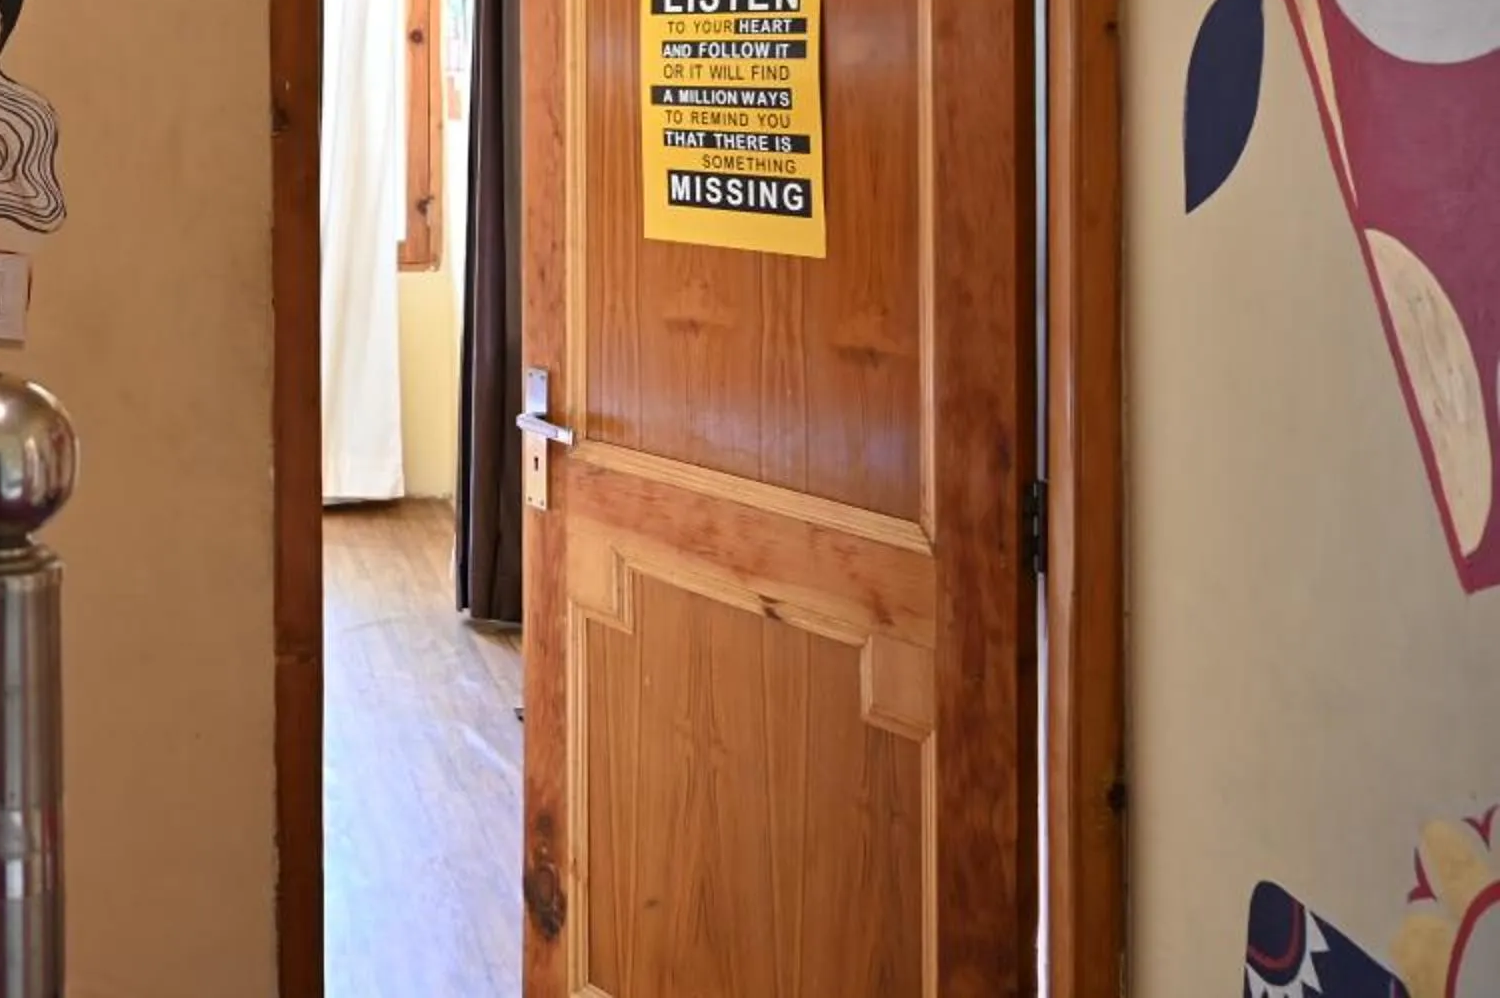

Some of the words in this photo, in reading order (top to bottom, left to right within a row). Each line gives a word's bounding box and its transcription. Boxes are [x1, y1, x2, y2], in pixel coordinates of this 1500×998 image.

[667, 20, 685, 35] TO
[693, 20, 733, 34] YOUR
[739, 19, 793, 33] HEART
[663, 44, 692, 58] AND
[699, 42, 770, 58] FOLLOW
[775, 43, 790, 57] IT
[663, 64, 685, 79] OR
[689, 65, 703, 79] IT
[709, 65, 745, 80] WILL
[751, 65, 790, 81] FIND
[663, 89, 673, 103] A
[679, 89, 738, 105] MILLION
[741, 91, 790, 107] WAYS
[665, 110, 683, 124] TO
[691, 111, 749, 127] REMIND
[757, 113, 791, 129] YOU
[665, 131, 708, 146] THAT
[713, 133, 769, 151] THERE
[775, 136, 792, 152] IS
[702, 154, 797, 173] SOMETHING
[671, 174, 804, 210] MISSING
